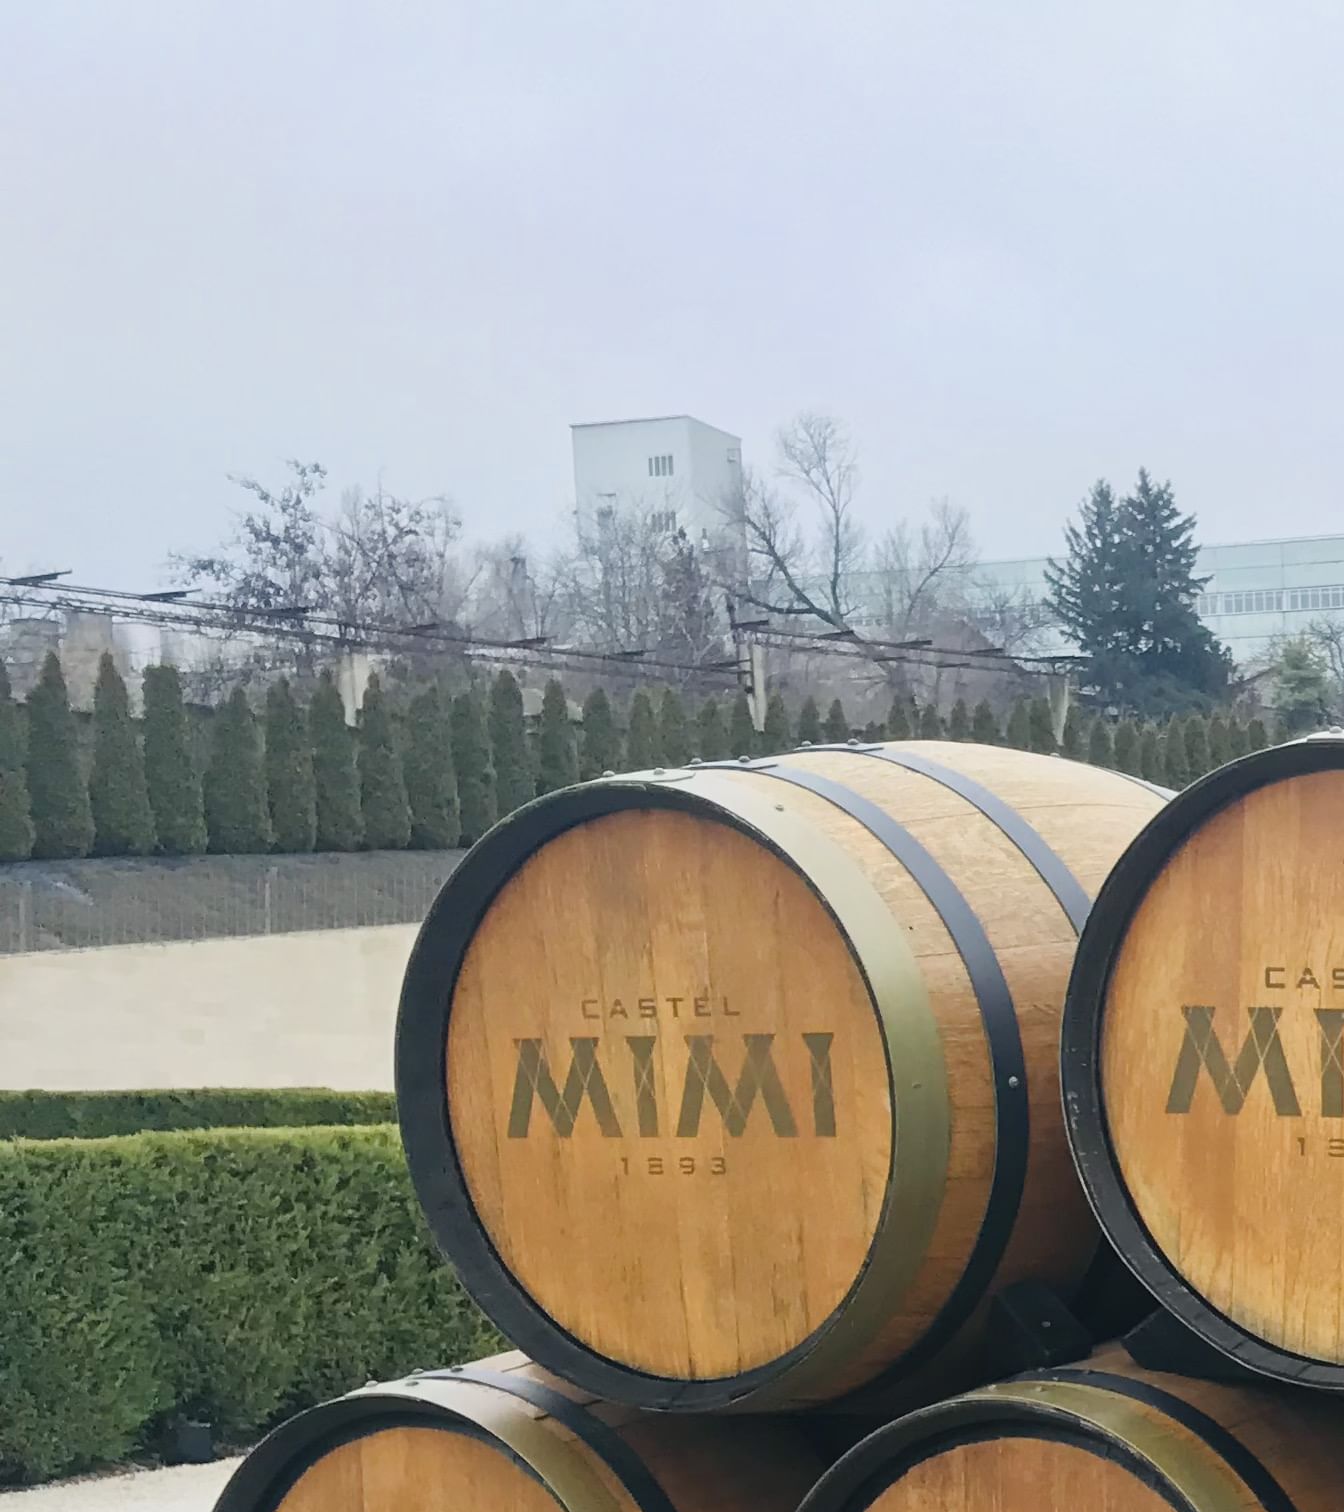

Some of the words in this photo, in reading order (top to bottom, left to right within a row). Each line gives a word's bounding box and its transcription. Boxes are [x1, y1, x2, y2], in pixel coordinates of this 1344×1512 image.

[578, 998, 741, 1020] CASTEL
[508, 1034, 835, 1137] MIMI
[618, 1155, 728, 1178] 1893
